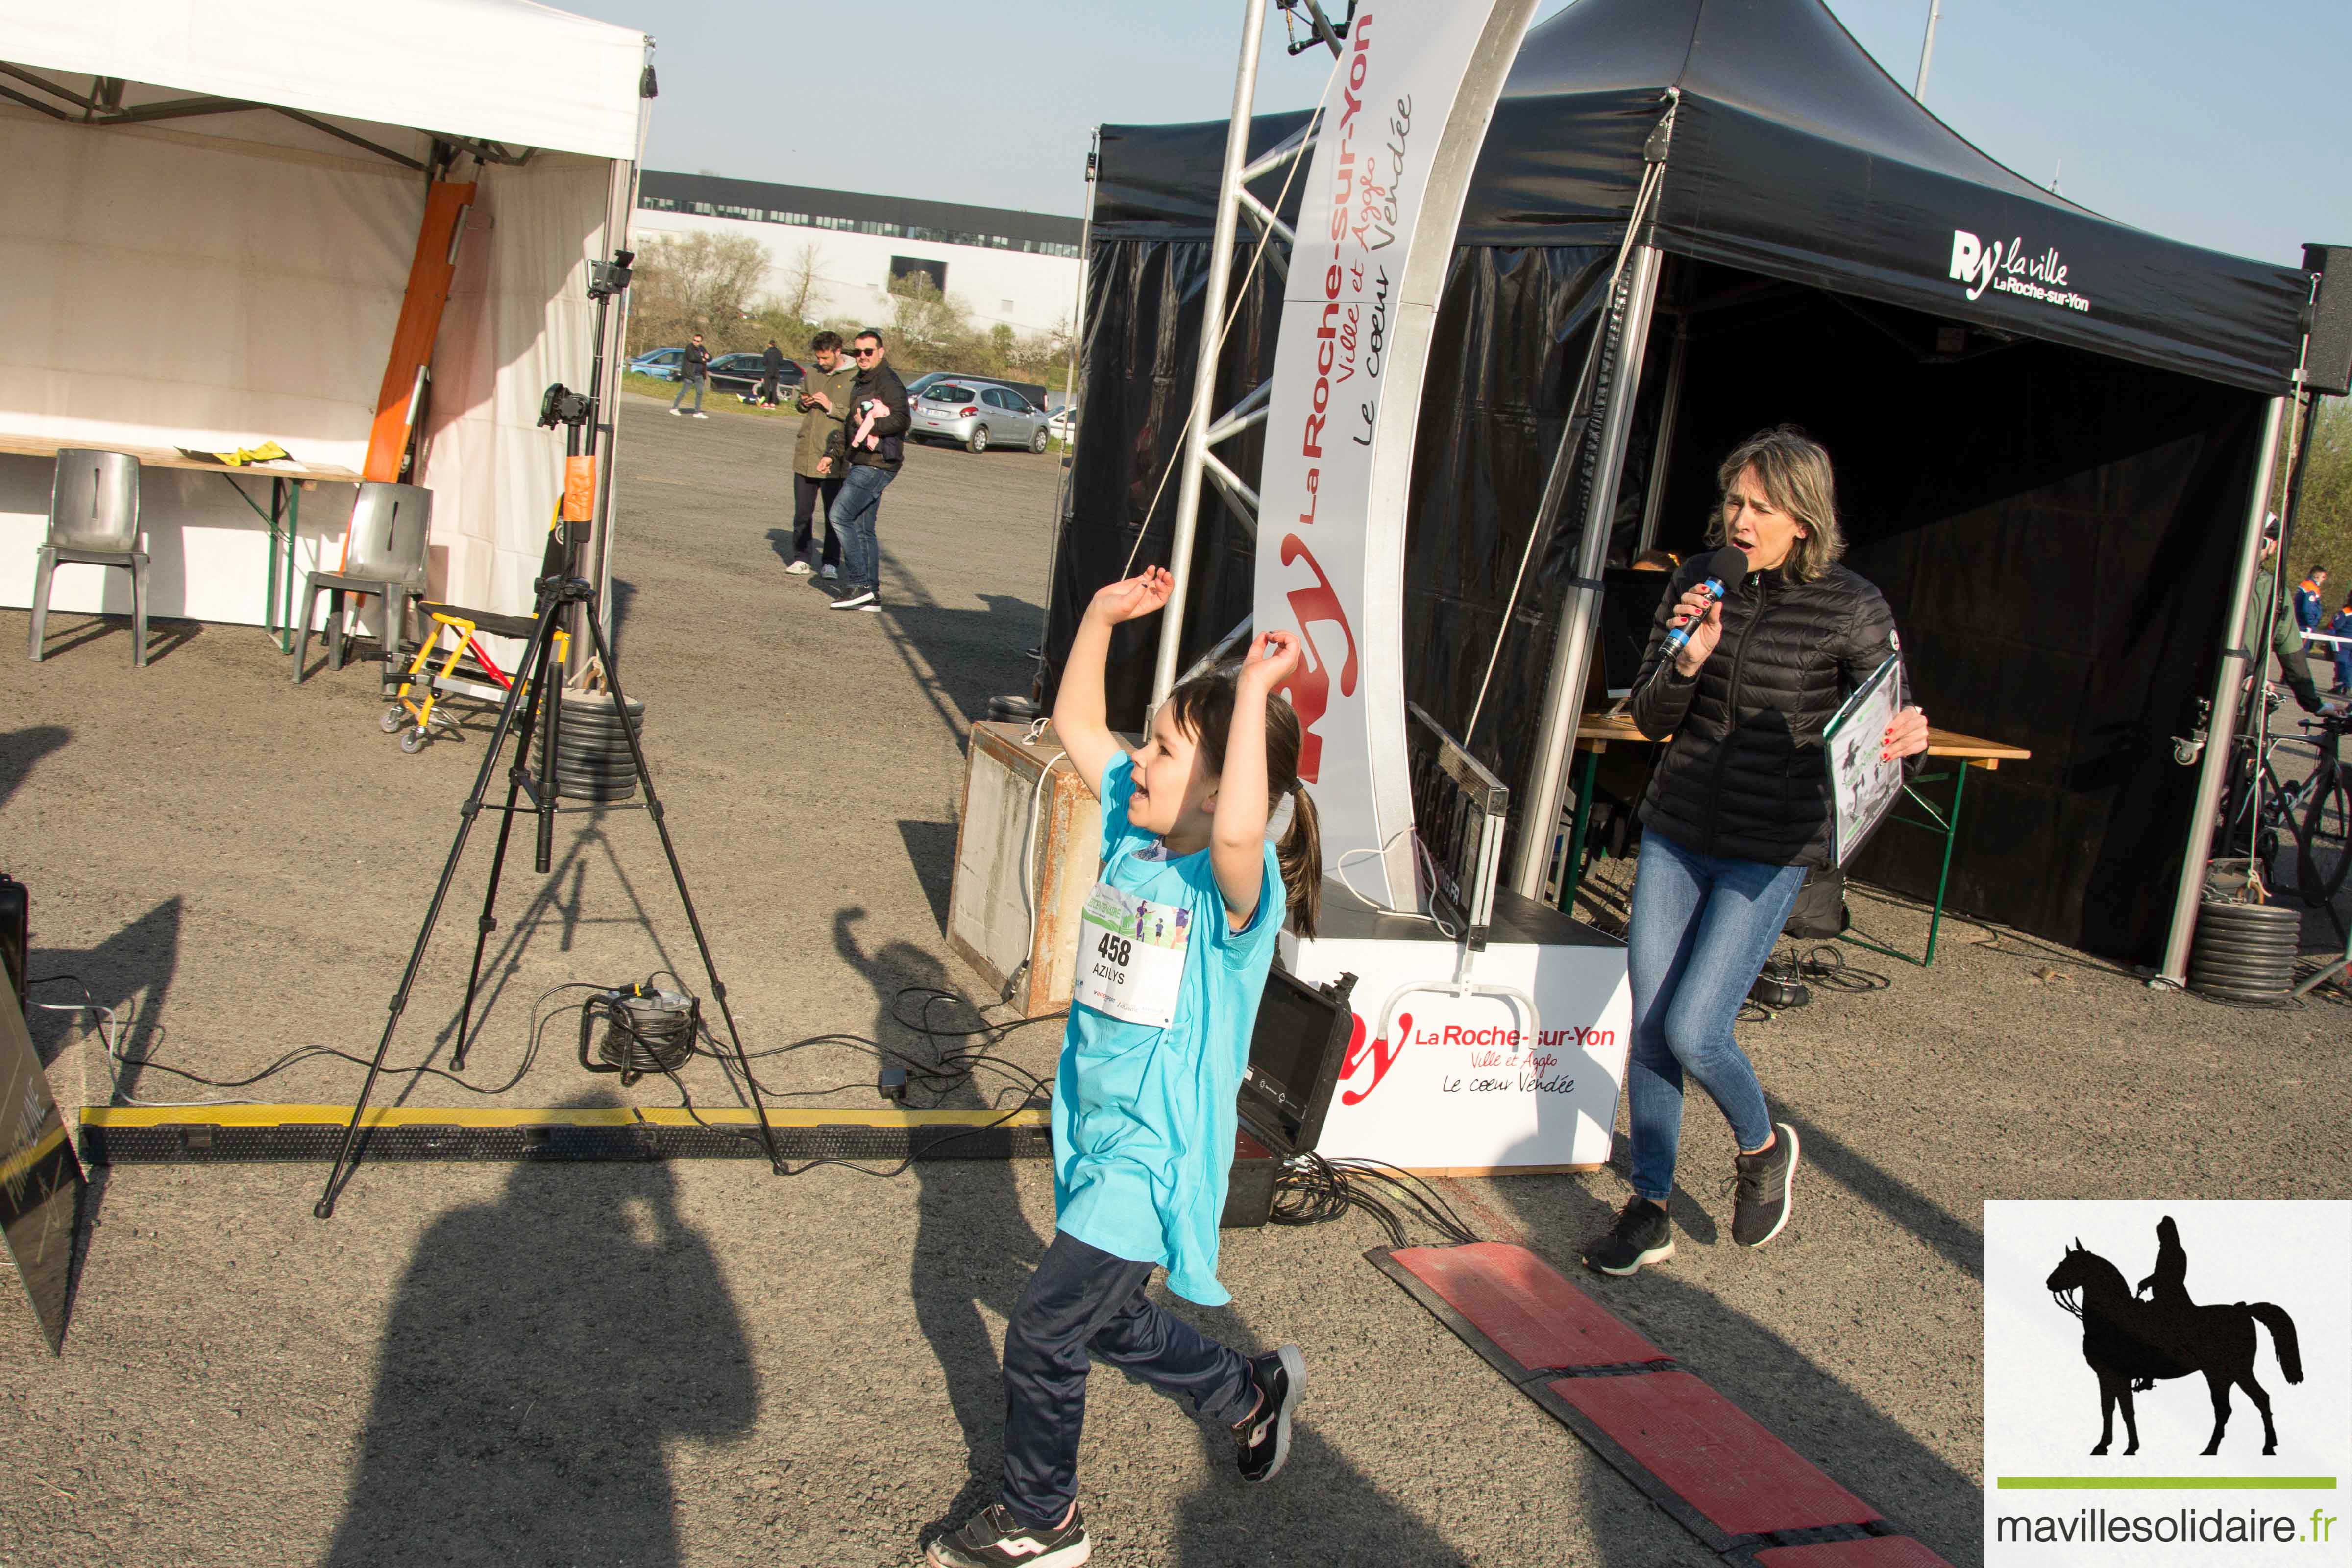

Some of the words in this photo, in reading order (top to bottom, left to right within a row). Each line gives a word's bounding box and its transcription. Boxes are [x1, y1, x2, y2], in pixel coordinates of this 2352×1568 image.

[1352, 157, 1386, 253] Agglo
[1303, 14, 1372, 458] Roche-sur-Yon
[1350, 258, 1364, 293] et
[1353, 400, 1374, 446] Le
[1371, 94, 1411, 251] Vendée
[2030, 247, 2069, 286] ville
[1337, 304, 1359, 383] Ville
[1300, 468, 1319, 524] La
[1098, 932, 1131, 967] 458
[1093, 963, 1125, 985] AZILYS
[1415, 1029, 1439, 1045] La
[1443, 1075, 1461, 1092] Le
[1519, 1071, 1575, 1094] Vendée
[1471, 1050, 1501, 1068] Ville
[1505, 1054, 1519, 1067] et
[1520, 1050, 1558, 1078] Agglo
